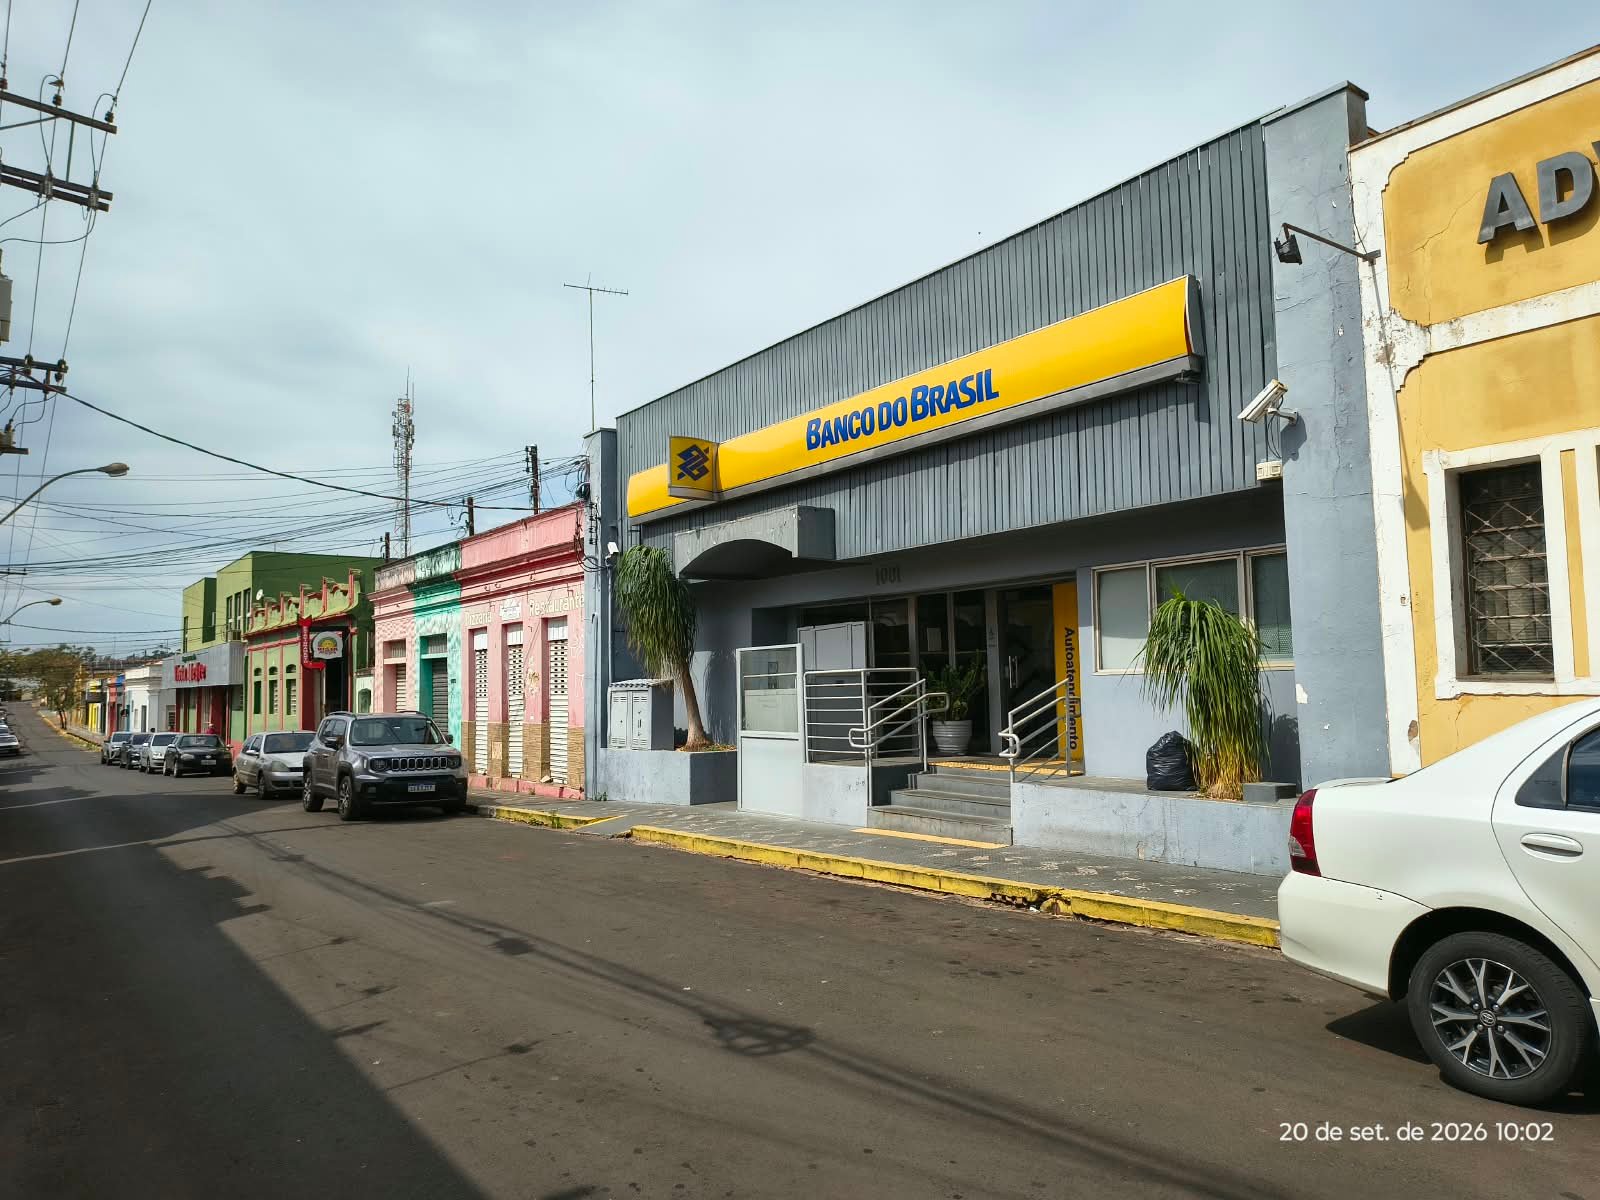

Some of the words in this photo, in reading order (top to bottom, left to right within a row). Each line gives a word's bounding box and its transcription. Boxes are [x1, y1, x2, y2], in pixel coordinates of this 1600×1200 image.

[1477, 140, 1600, 245] AD
[806, 406, 876, 451] BANCO
[878, 396, 908, 432] DO
[911, 368, 1000, 423] BRASIL
[529, 591, 584, 617] Restaurante
